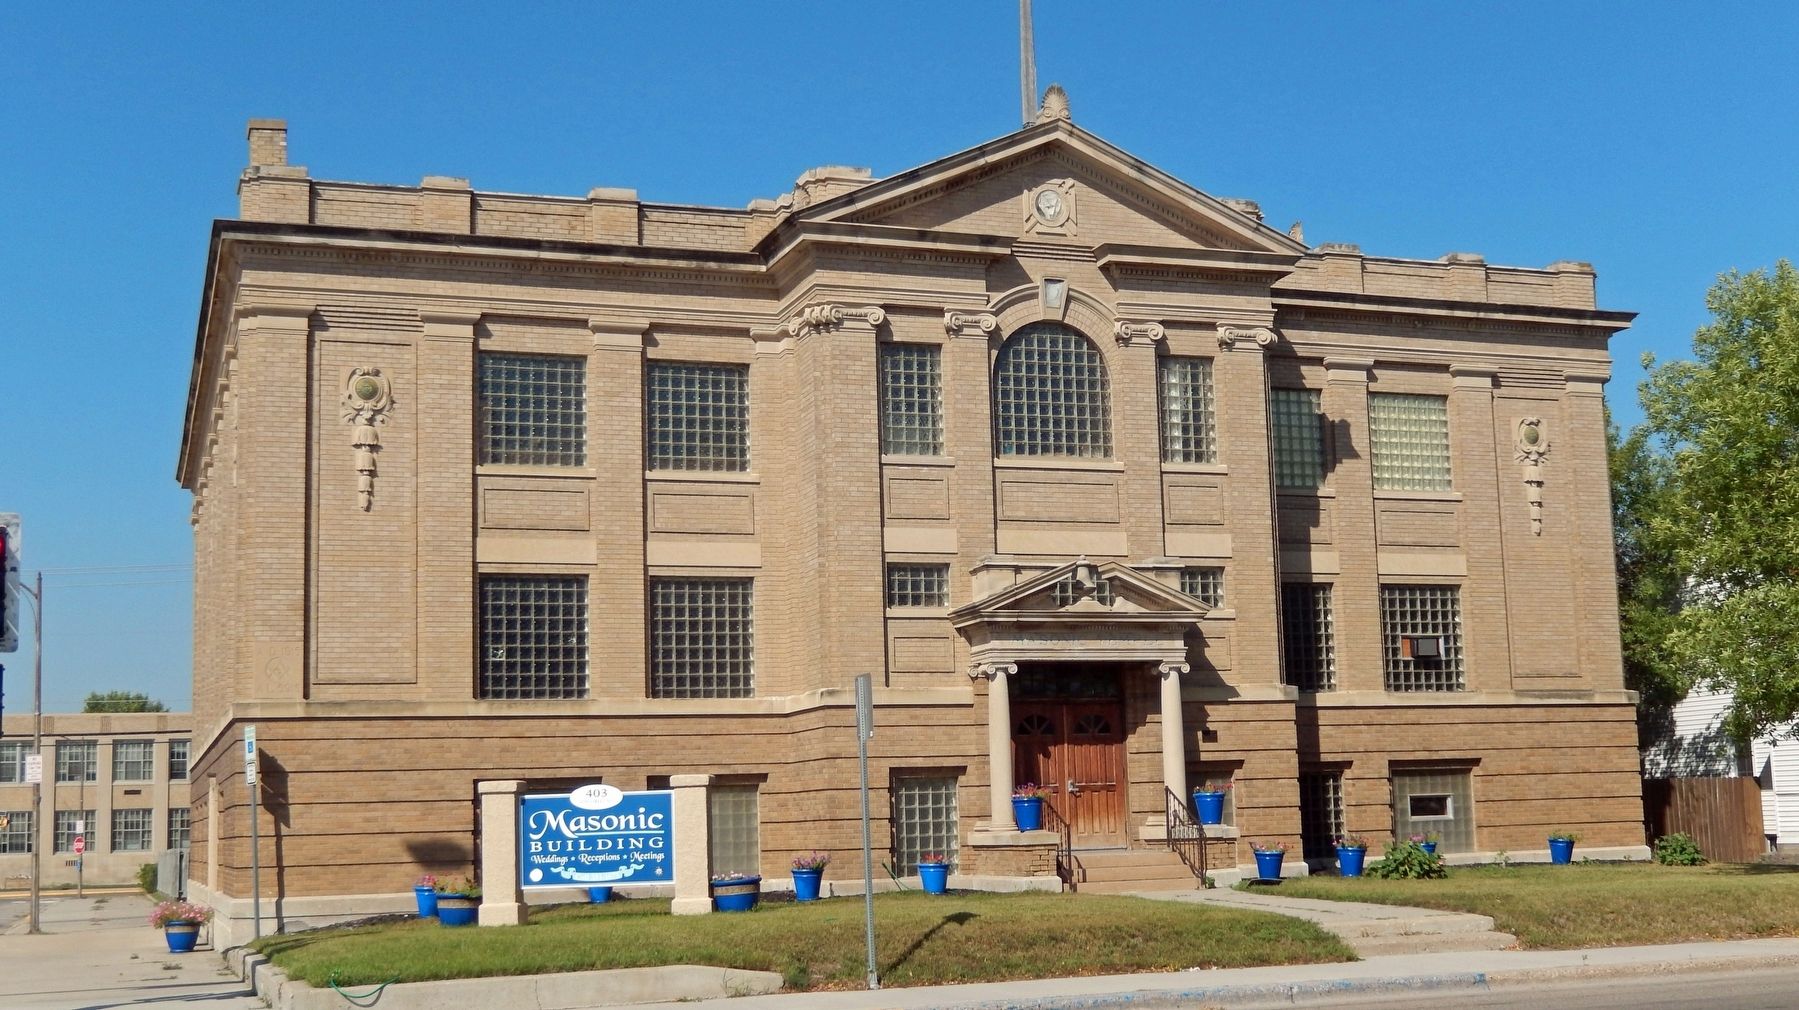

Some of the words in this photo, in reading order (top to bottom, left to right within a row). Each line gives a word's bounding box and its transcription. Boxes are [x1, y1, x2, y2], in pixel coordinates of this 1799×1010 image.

[586, 788, 608, 798] 403
[529, 807, 664, 840] Masonic
[529, 837, 664, 853] BUILDING
[531, 854, 569, 865] Weddings
[578, 853, 620, 865] Receptions
[630, 851, 665, 863] Meetings
